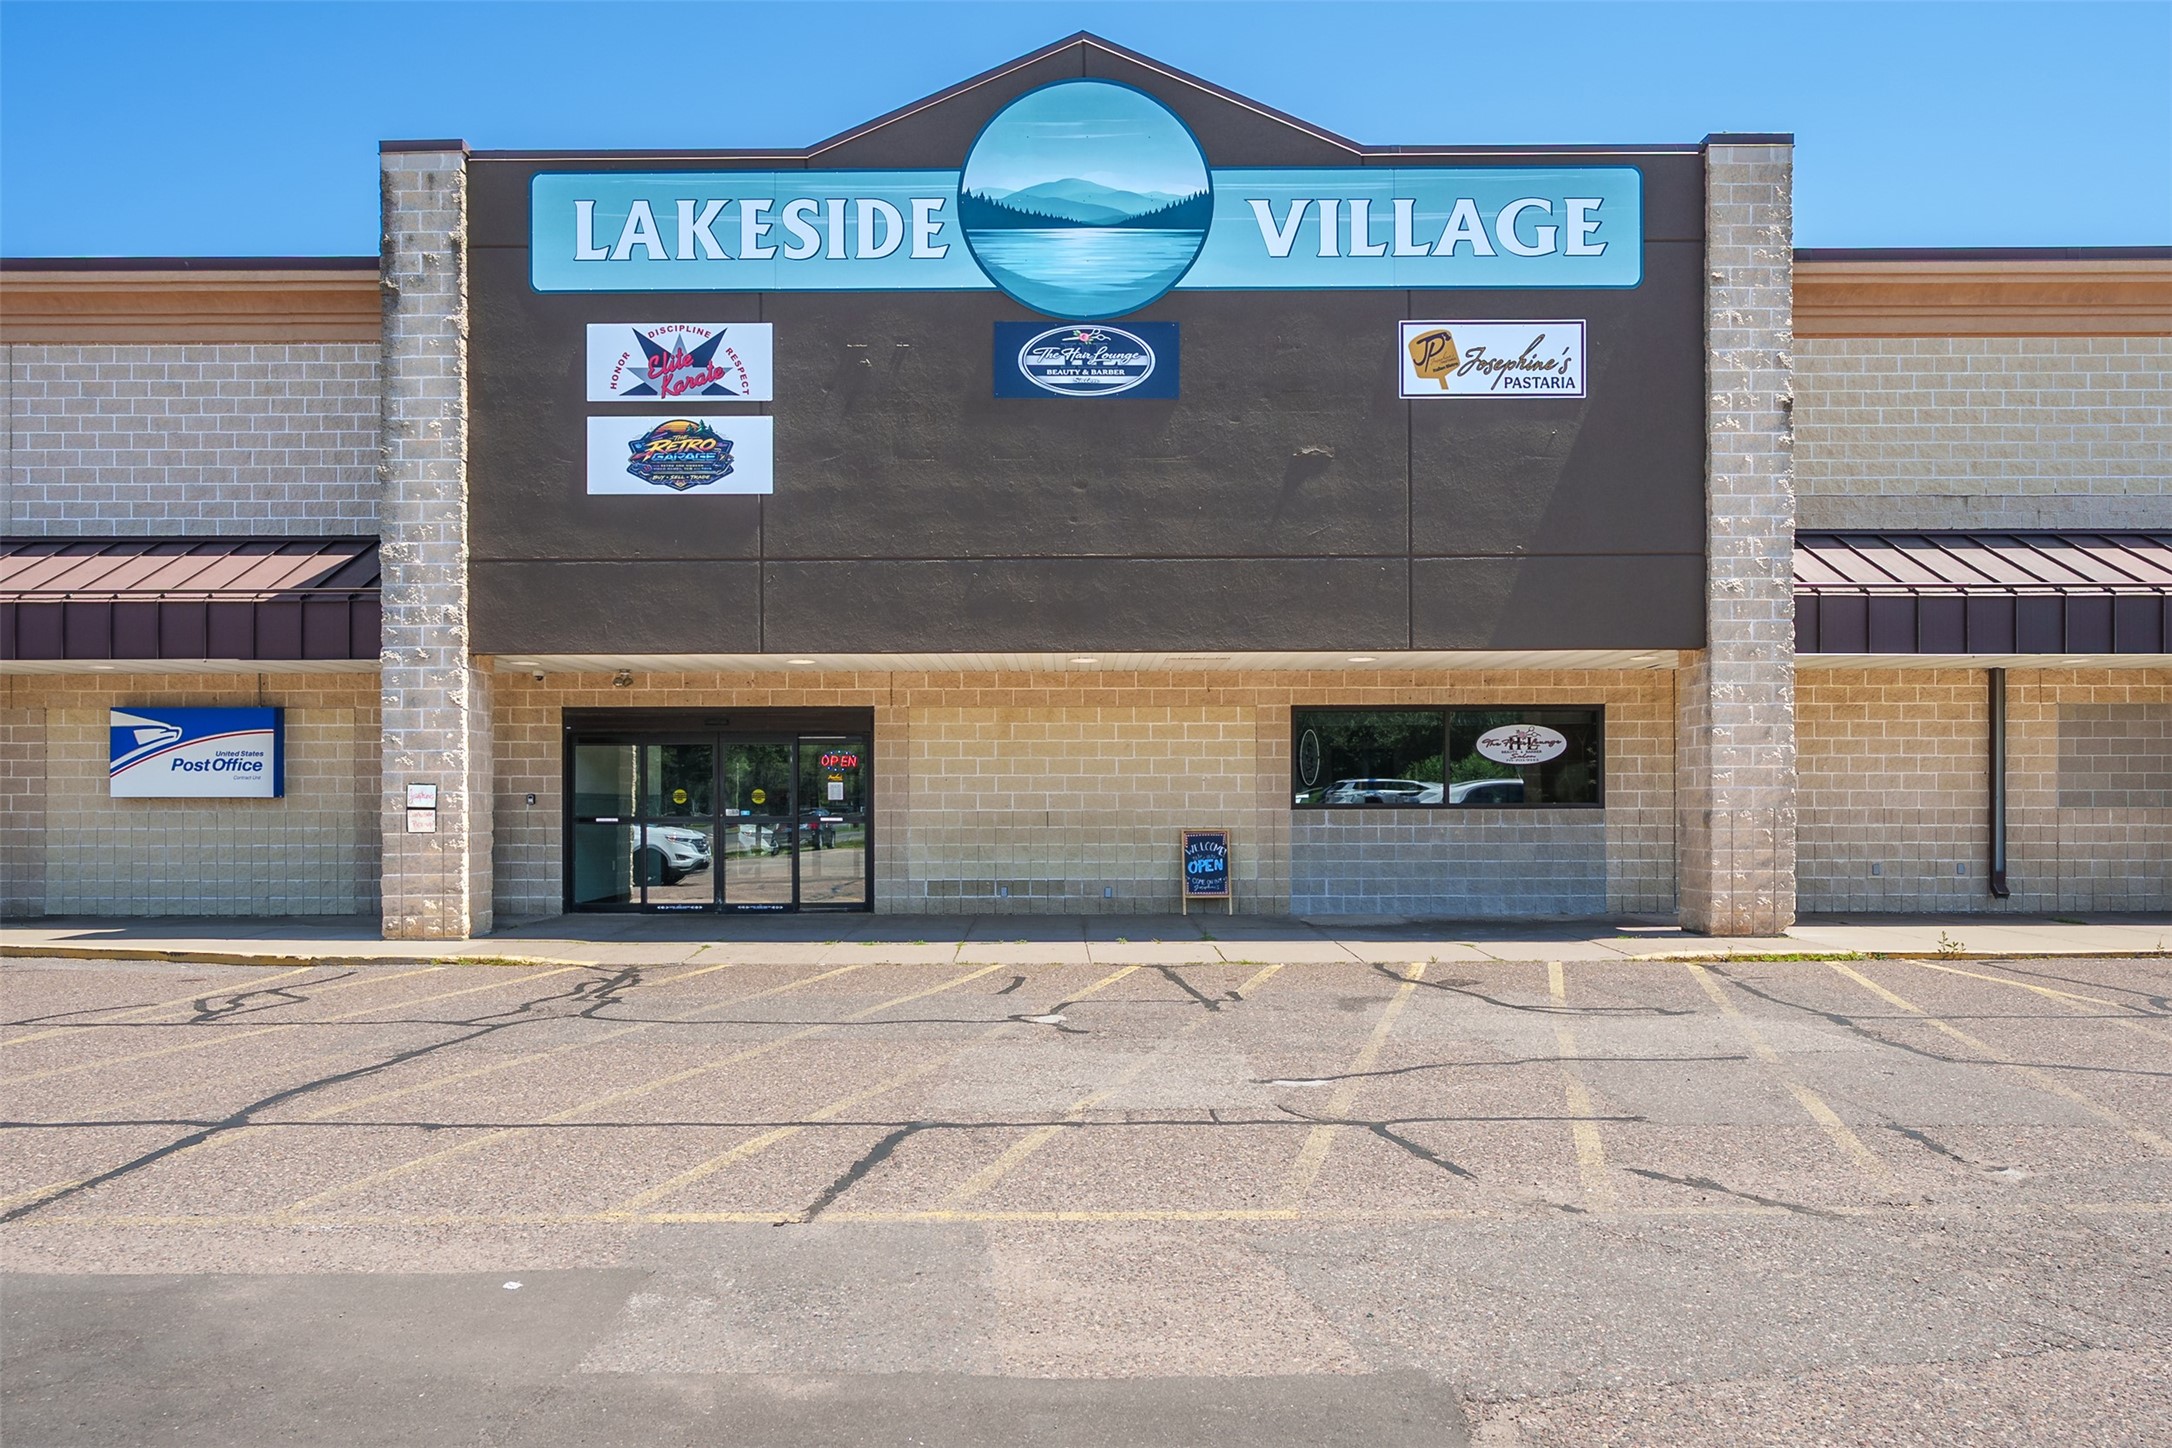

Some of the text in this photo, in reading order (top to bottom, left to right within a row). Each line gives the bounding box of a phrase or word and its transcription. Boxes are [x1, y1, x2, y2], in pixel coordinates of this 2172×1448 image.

[573, 197, 1609, 261] LAKESIDE VILLAGE
[648, 325, 711, 339] DISCIPLINE
[647, 347, 694, 379] Elite
[1033, 346, 1141, 365] The Hair Lounge
[1457, 333, 1572, 391] Josephine's
[610, 352, 630, 389] HONOR
[661, 359, 725, 399] Karate
[725, 347, 749, 395] RESPECT
[1504, 377, 1576, 389] PASTARIA
[644, 438, 717, 453] RETRO
[651, 453, 716, 461] GARAGE
[171, 758, 263, 772] Post Office
[821, 755, 858, 767] OPEN
[1188, 858, 1223, 874] OPEN
